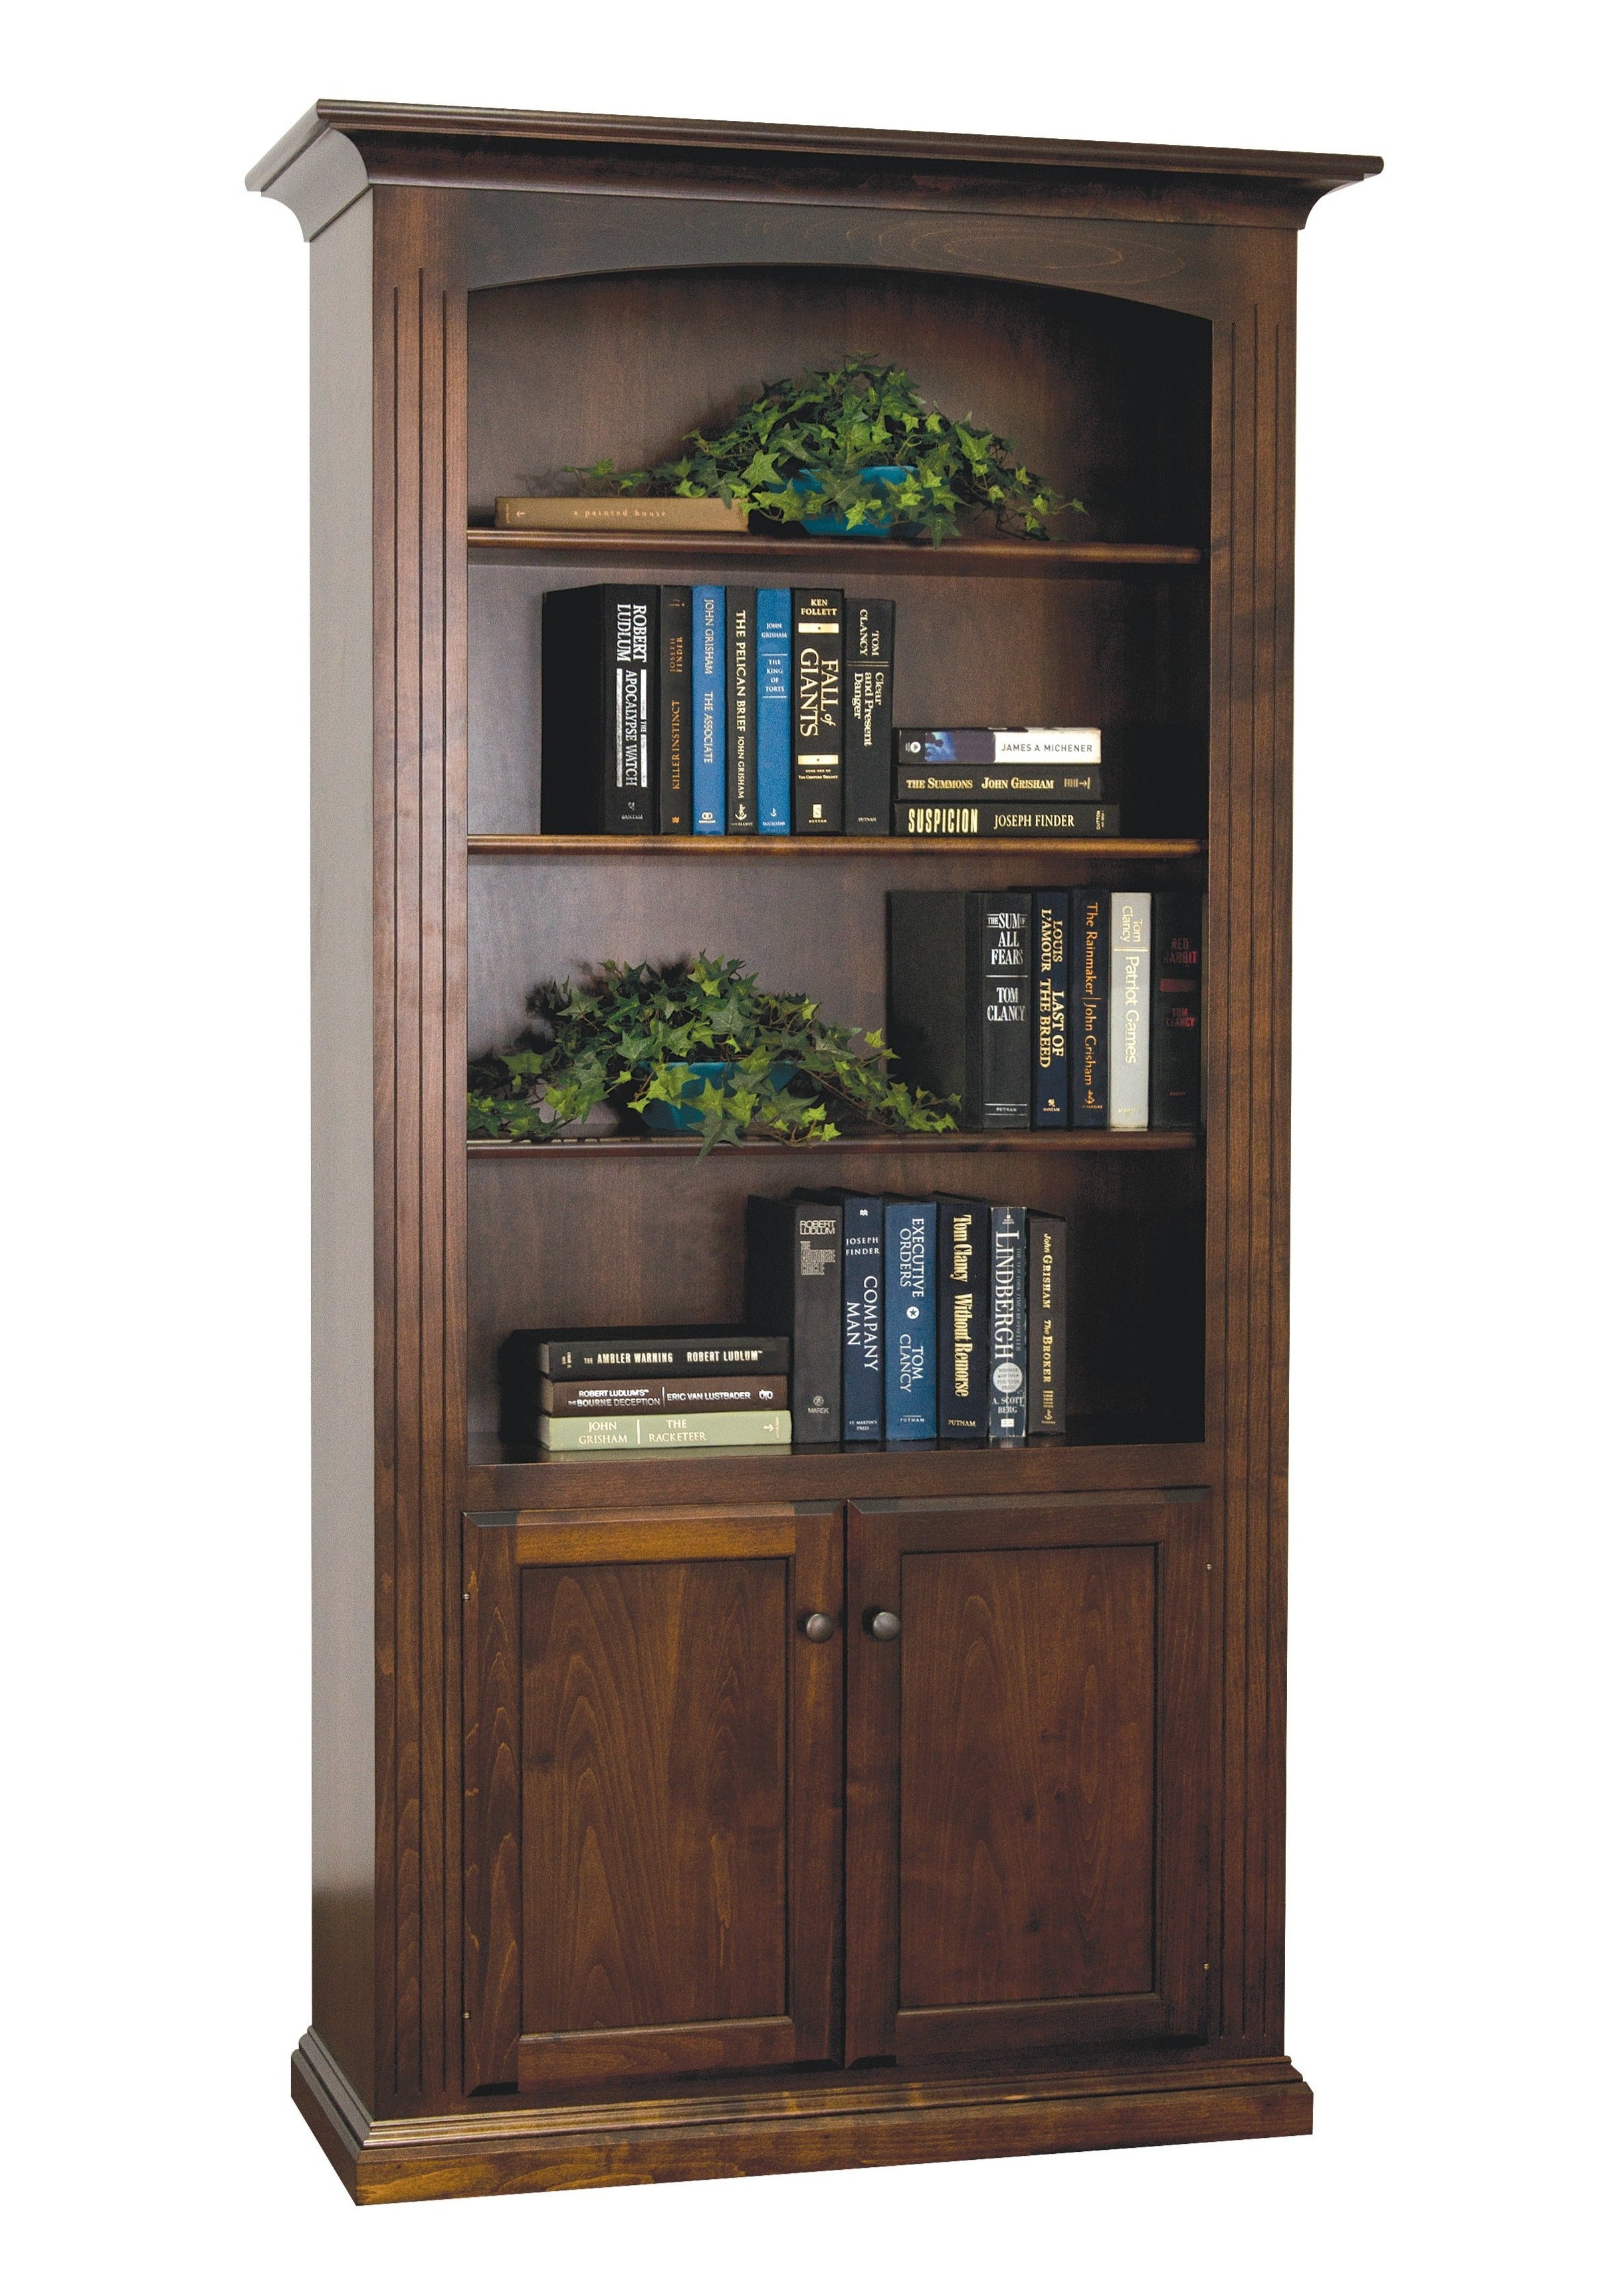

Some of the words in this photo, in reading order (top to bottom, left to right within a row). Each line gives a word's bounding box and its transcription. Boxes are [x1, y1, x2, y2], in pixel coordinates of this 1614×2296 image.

[704, 599, 714, 626] JOHN
[736, 611, 746, 637] THE
[617, 604, 631, 662] LUDLUM
[633, 605, 647, 662] ROBERT
[704, 628, 714, 674] GRISHAM
[736, 642, 746, 696] PELICAN
[821, 659, 839, 711] FALL
[625, 670, 638, 741] APOCALYPSE
[704, 692, 713, 712] THE
[800, 648, 819, 737] GIANTS
[854, 673, 863, 719] Danger
[875, 672, 884, 705] Clear
[736, 700, 746, 731] BRIEF
[821, 714, 836, 726] of
[864, 700, 873, 746] Present
[704, 714, 713, 763] ASSOCIATE
[625, 743, 637, 787] WATCH
[906, 779, 925, 789] THE
[928, 777, 973, 789] SUMMONS
[981, 777, 1007, 789] JOHN
[1011, 777, 1054, 789] GRISHAM
[908, 809, 978, 833] SUSPICION
[994, 814, 1031, 829] JOSEPH
[1035, 814, 1074, 826] FINDER
[999, 913, 1021, 929] SUM
[1086, 902, 1098, 927] The
[1122, 906, 1133, 943] Clancy
[1133, 919, 1143, 943] Tom
[991, 949, 1023, 965] FEARS
[998, 931, 1019, 947] ALL
[1041, 909, 1052, 972] L'AMOUR
[1053, 920, 1063, 963] LOUIS
[1084, 931, 1098, 995] Rainmaker
[1126, 956, 1140, 1005] Patriot
[987, 1005, 1025, 1022] CLANCY
[997, 987, 1019, 1003] TOM
[1040, 978, 1051, 1012] THE
[1052, 991, 1064, 1032] LAST
[1084, 1003, 1097, 1032] John
[1039, 1016, 1051, 1068] BREED
[1052, 1034, 1064, 1057] OF
[1126, 1010, 1139, 1064] Games
[1084, 1035, 1096, 1086] Grisham
[953, 1214, 972, 1242] Tom
[900, 1228, 911, 1287] ORDERS
[912, 1218, 924, 1297] EXECUTIVE
[950, 1243, 971, 1283] Clancy
[995, 1231, 1019, 1359] LINDBERGH
[1043, 1254, 1053, 1309] GRISHAM
[847, 1302, 860, 1345] MAN
[864, 1276, 878, 1371] COMPANY
[954, 1293, 973, 1339] Without
[597, 1353, 631, 1363] AMBLER
[635, 1352, 672, 1363] WARNING
[687, 1351, 720, 1362] ROBERT
[900, 1334, 911, 1392] CLANCY
[912, 1346, 924, 1380] TOM
[954, 1341, 973, 1396] Remorse
[1043, 1337, 1053, 1383] BROKER
[704, 1391, 750, 1400] LUSTBADER
[579, 1434, 628, 1444] GRISHAM
[589, 1422, 617, 1432] JOHN
[649, 1432, 707, 1442] RACKETEER
[666, 1419, 686, 1428] THE
